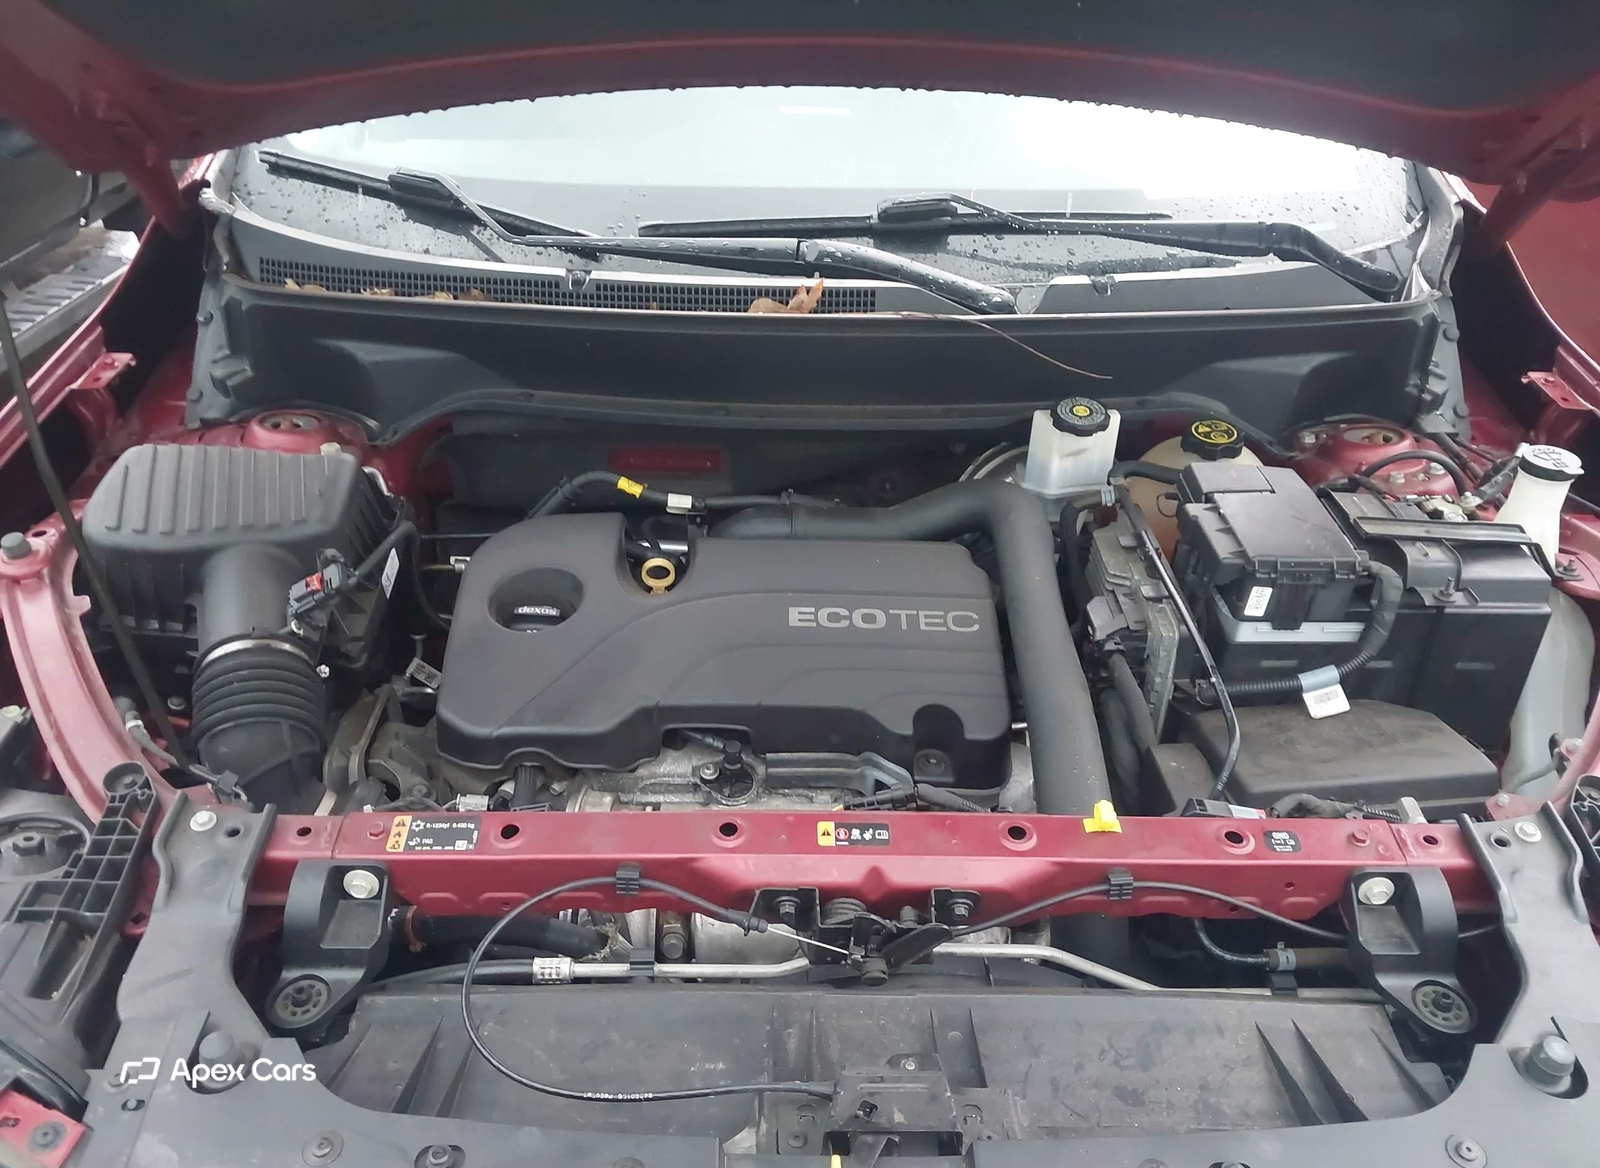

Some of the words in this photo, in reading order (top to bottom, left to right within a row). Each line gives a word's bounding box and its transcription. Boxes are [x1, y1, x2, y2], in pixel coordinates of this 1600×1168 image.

[518, 606, 557, 615] dexos
[788, 606, 980, 632] ECOTEC
[467, 822, 475, 830] kg
